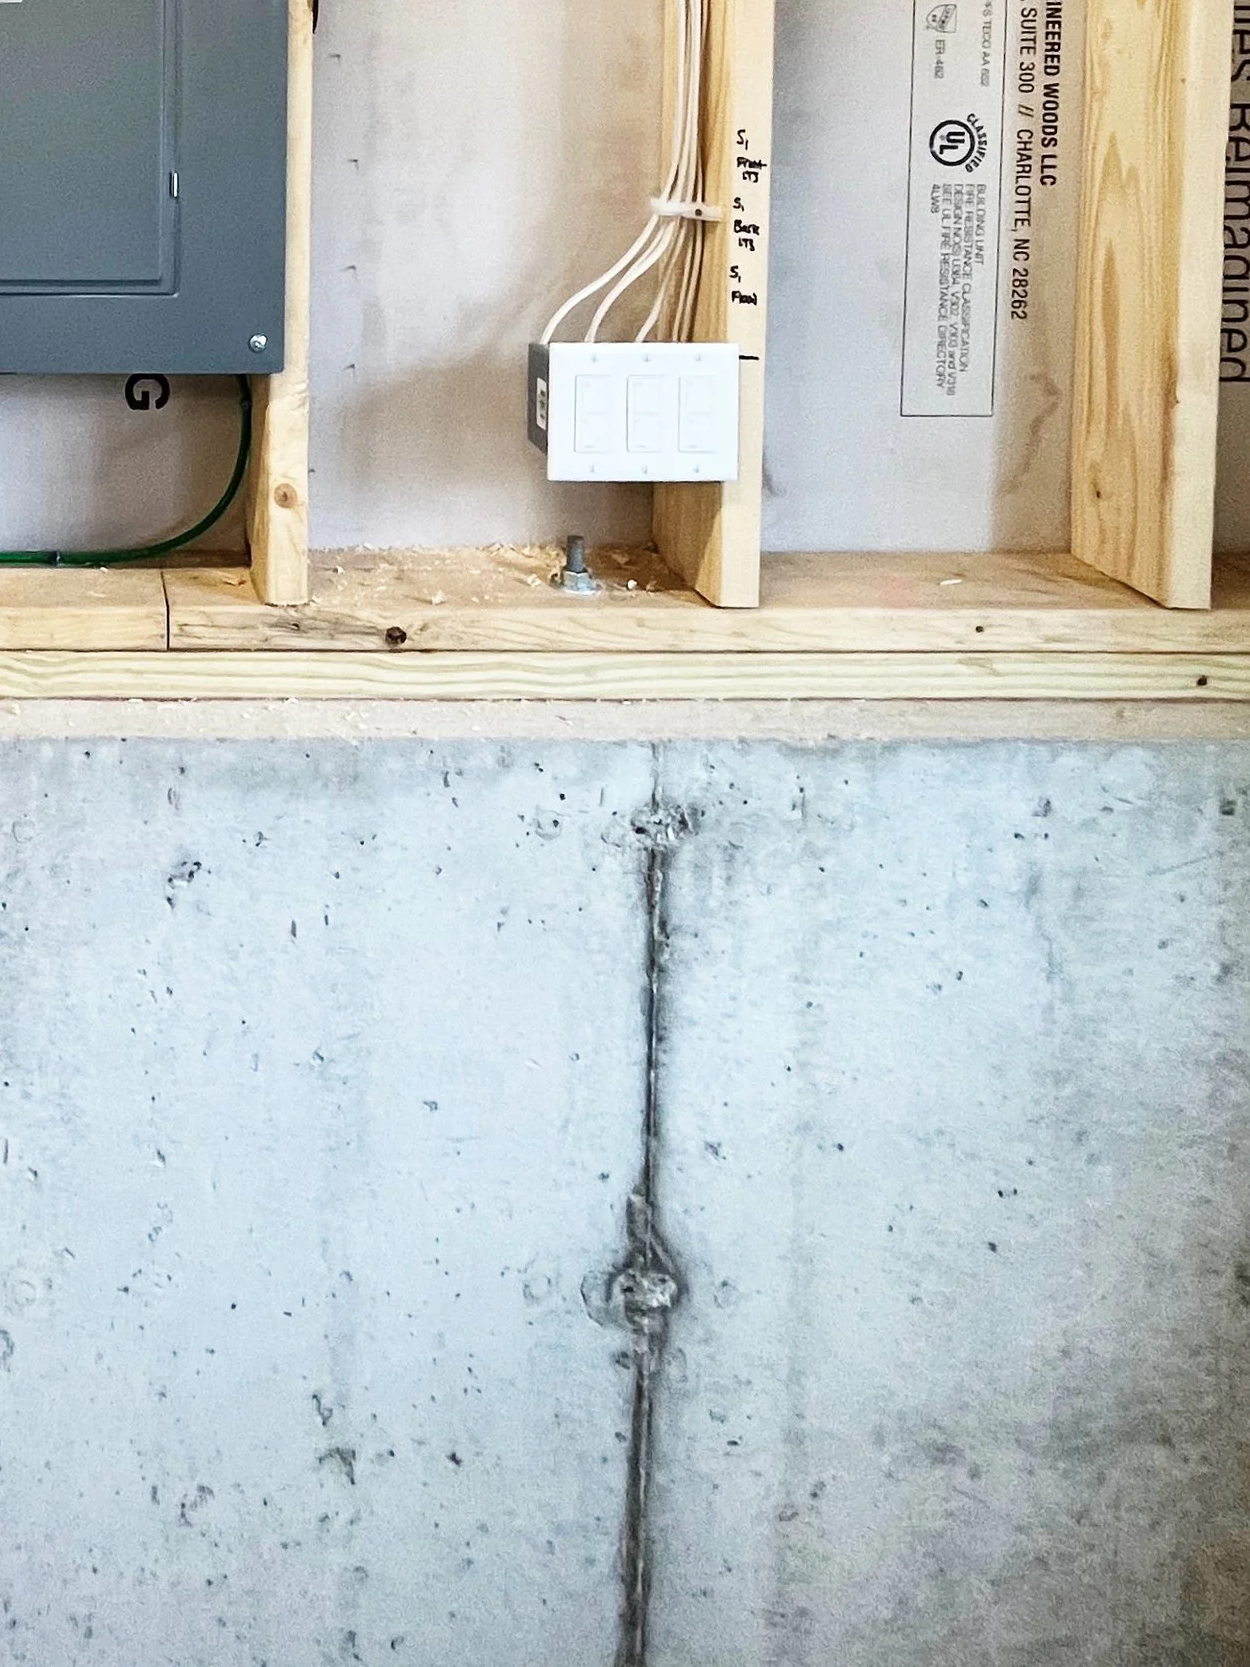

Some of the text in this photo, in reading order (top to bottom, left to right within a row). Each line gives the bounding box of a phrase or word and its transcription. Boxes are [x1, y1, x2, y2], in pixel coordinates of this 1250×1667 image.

[1020, 7, 1037, 56] SUITE
[1018, 62, 1034, 93] 300
[1040, 83, 1060, 147] WOODS
[938, 131, 965, 155] UL
[964, 113, 988, 173] CLASSIFIED
[1011, 129, 1032, 232] CHARLOTTE,
[1040, 153, 1058, 186] LLC
[1013, 239, 1030, 261] NC
[1011, 268, 1028, 320] 28262
